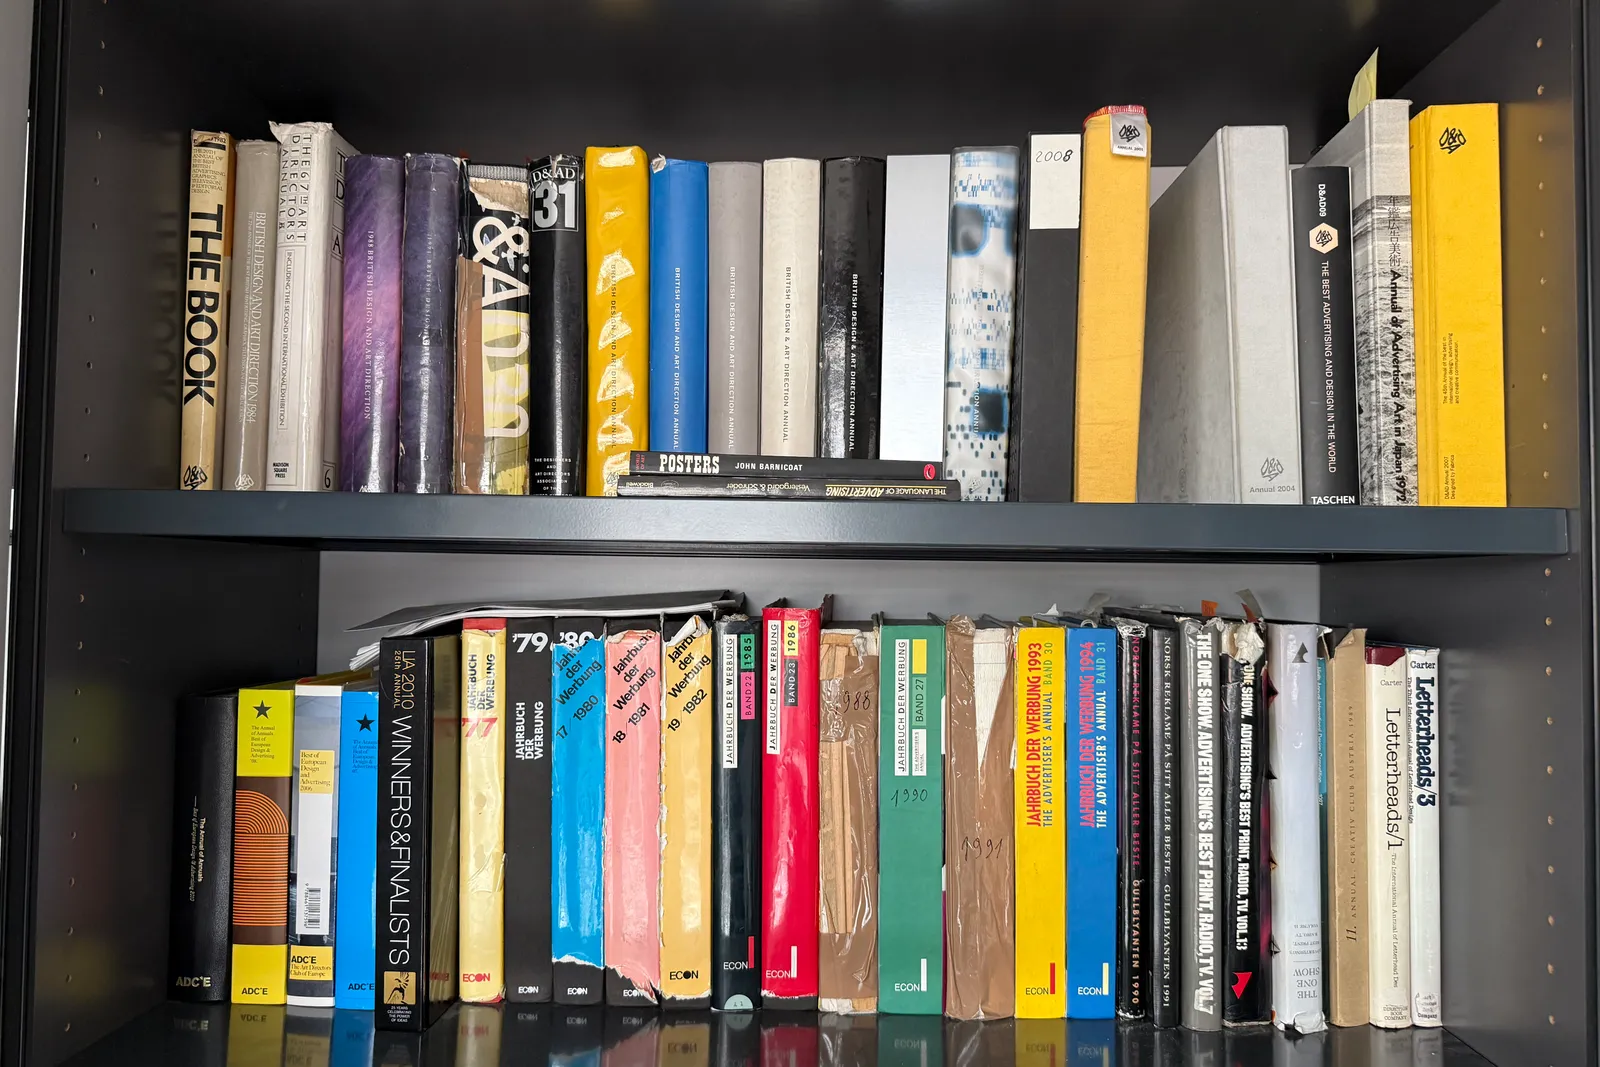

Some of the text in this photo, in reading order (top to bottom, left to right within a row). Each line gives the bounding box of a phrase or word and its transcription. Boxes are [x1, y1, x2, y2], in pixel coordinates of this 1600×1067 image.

[1035, 149, 1073, 163] 2008
[287, 135, 300, 240] DIRECTORS
[533, 167, 575, 182] D&AD
[534, 180, 576, 229] 31
[1318, 184, 1327, 217] D&AD09
[189, 204, 223, 282] THE
[367, 230, 375, 248] 1988
[184, 290, 219, 407] BOOK
[365, 326, 373, 347] AND
[1321, 261, 1336, 473] THE BEST ADVERTISING AND DESIGN IN THE WORLD
[364, 369, 372, 420] DIRECTION
[1390, 270, 1406, 502] Annual of Advertising Art in Japan 1972
[659, 454, 803, 474] POSTERS JOHN BARNICOAT
[759, 483, 766, 491] &
[767, 482, 811, 492] Vestergaard
[826, 486, 885, 497] ADVERTISING
[885, 487, 895, 495] OF
[896, 487, 933, 496] LANGUAGE
[934, 488, 946, 496] THE
[1277, 485, 1296, 493] 2004
[1311, 496, 1355, 505] TASCHEN
[512, 632, 549, 653] '79
[744, 637, 752, 666] 1985
[769, 624, 777, 671] WERBUNG
[787, 625, 796, 652] 1986
[1197, 632, 1212, 659] THE
[565, 660, 584, 679] der
[678, 652, 695, 671] der
[898, 641, 906, 692] WERBUNG
[1164, 637, 1172, 677] NORSK
[1410, 660, 1436, 669] Carter
[468, 654, 477, 711] JAHRBUCH
[486, 653, 495, 711] WERBUNG
[555, 660, 603, 706] Werbung
[623, 664, 640, 683] der
[668, 654, 711, 698] Werbung
[745, 676, 752, 687] 22
[788, 662, 796, 703] BAND 23
[1197, 660, 1212, 687] ONE
[401, 673, 415, 710] 2010
[613, 667, 656, 711] Werbung
[915, 679, 924, 722] BAND 27
[1164, 682, 1172, 740] REKLAME
[1197, 688, 1213, 729] SHOW.
[515, 702, 525, 761] JAHRBUCH
[534, 701, 544, 760] WERBUNG
[612, 702, 651, 744] 18 1981
[1026, 643, 1042, 827] JAHRBUCH DER WERBUNG 1993
[1042, 642, 1053, 827] THE ADVERTISER'S ANNUAL BAND 30
[1079, 641, 1095, 828] JAHRBUCH DER WERBUNG 1994
[1096, 642, 1107, 828] THE ADVERTISER'S ANNUAL BAND 31
[525, 739, 534, 760] DER
[1164, 743, 1173, 757] PÅ
[1414, 677, 1437, 807] Letterheads/3
[300, 779, 331, 787] Advertising
[1198, 731, 1213, 831] ADVERTISING'S
[1163, 835, 1171, 876] BESTE.
[1198, 833, 1214, 868] BEST
[1196, 870, 1214, 910] PRINT,
[1163, 884, 1171, 979] GULLBLYANTEN
[1196, 913, 1214, 956] RADIO,
[1345, 926, 1357, 941] 11.
[463, 973, 490, 982] ECON
[670, 970, 699, 980] ECON
[723, 961, 748, 970] ECON
[766, 970, 790, 978] ECON
[1199, 956, 1214, 976] TV.
[1293, 967, 1320, 977] SHOW
[518, 986, 539, 994] ECON
[894, 983, 920, 992] ECON
[1025, 987, 1049, 995] ECON
[1077, 987, 1102, 995] ECON
[1296, 979, 1318, 988] ONE
[1297, 990, 1317, 999] THE
